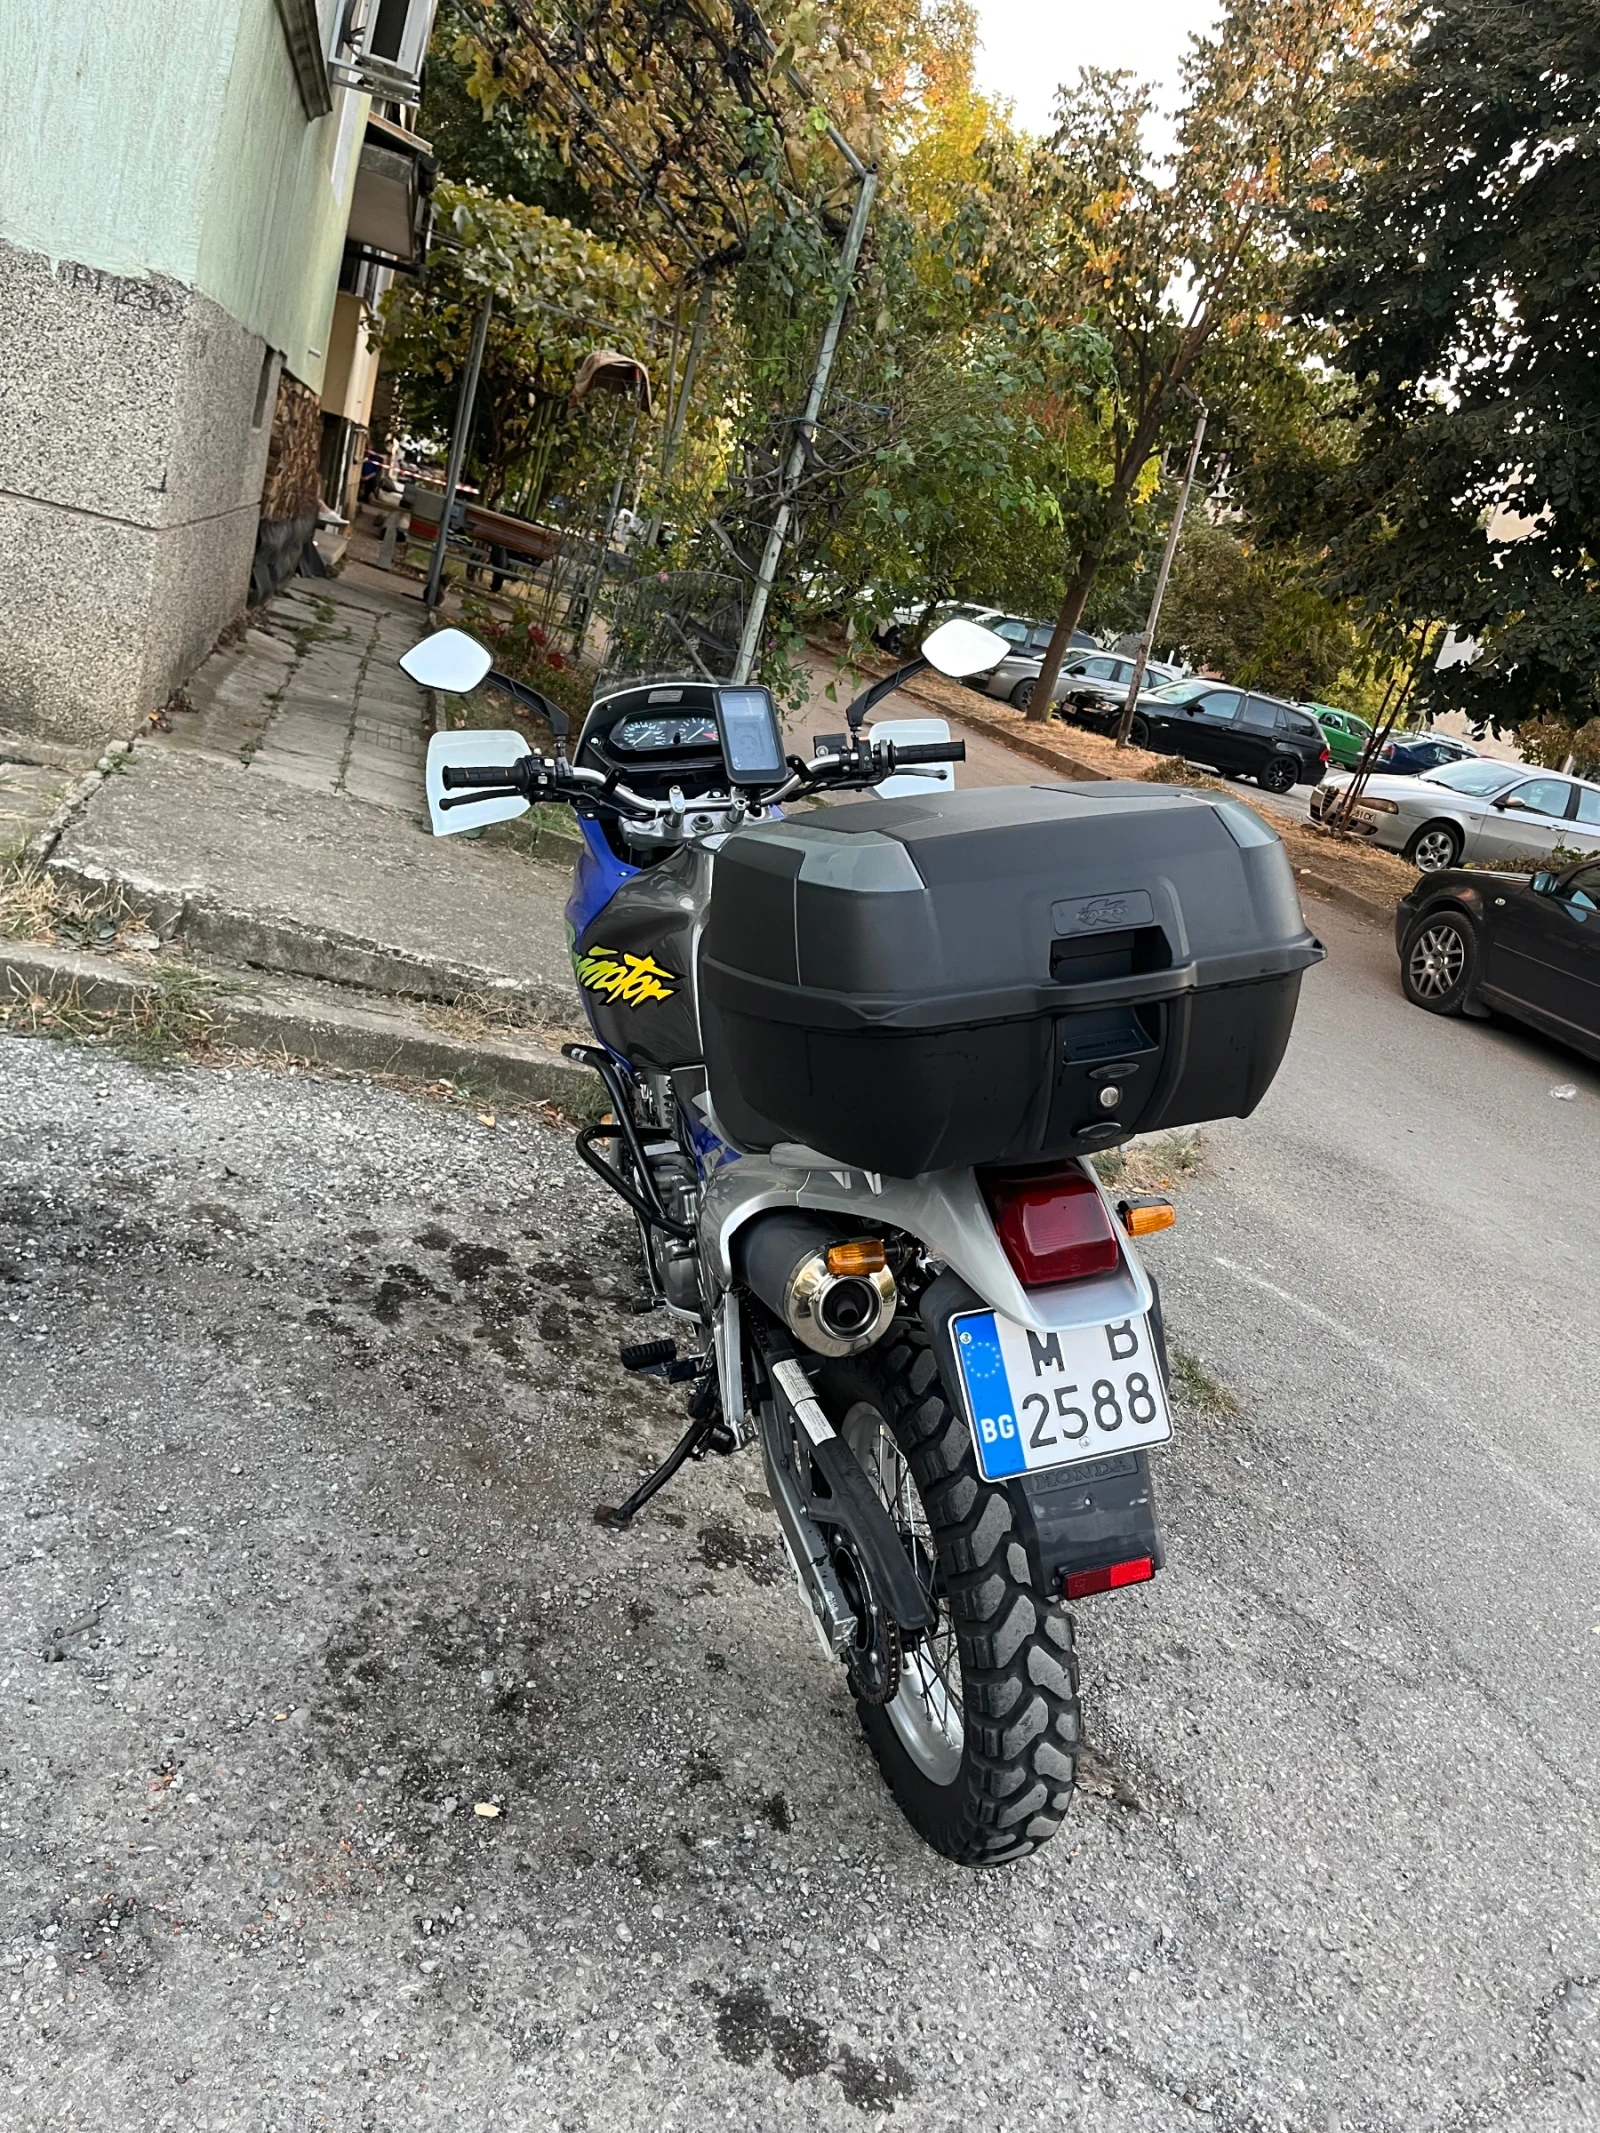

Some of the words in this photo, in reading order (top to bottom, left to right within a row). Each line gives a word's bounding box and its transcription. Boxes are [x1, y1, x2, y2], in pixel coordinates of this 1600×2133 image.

[1026, 1328, 1066, 1377] M
[1104, 1319, 1139, 1361] B
[980, 1413, 1015, 1444] BG
[1021, 1371, 1157, 1450] 2588
[1034, 1458, 1133, 1490] HONDA
